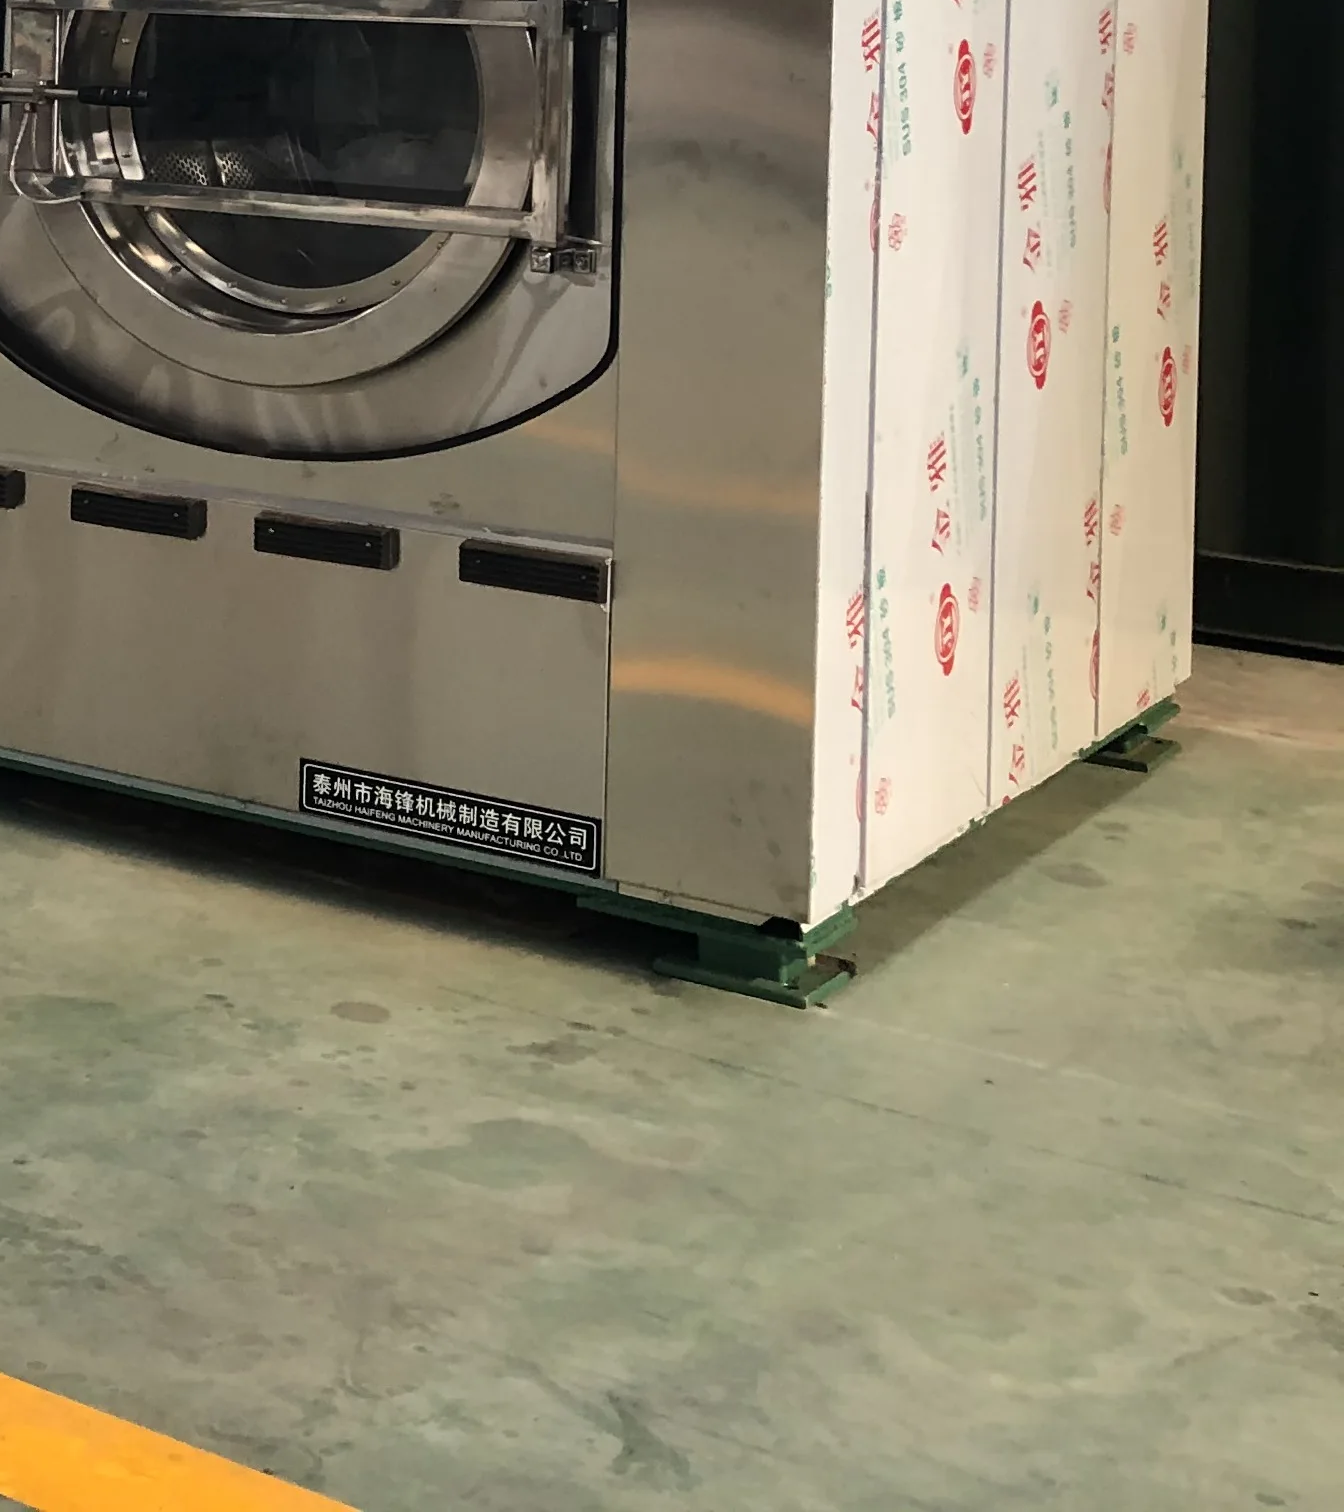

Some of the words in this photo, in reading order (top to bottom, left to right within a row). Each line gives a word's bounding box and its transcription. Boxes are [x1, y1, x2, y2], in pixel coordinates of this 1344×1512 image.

[313, 773, 587, 850] 泰州市海锋机械制造有限公司
[313, 796, 352, 812] TAIZHOU
[354, 805, 396, 821] HAIFENG
[398, 815, 454, 834] MACHINERY
[457, 827, 541, 853] MANUFACTURING
